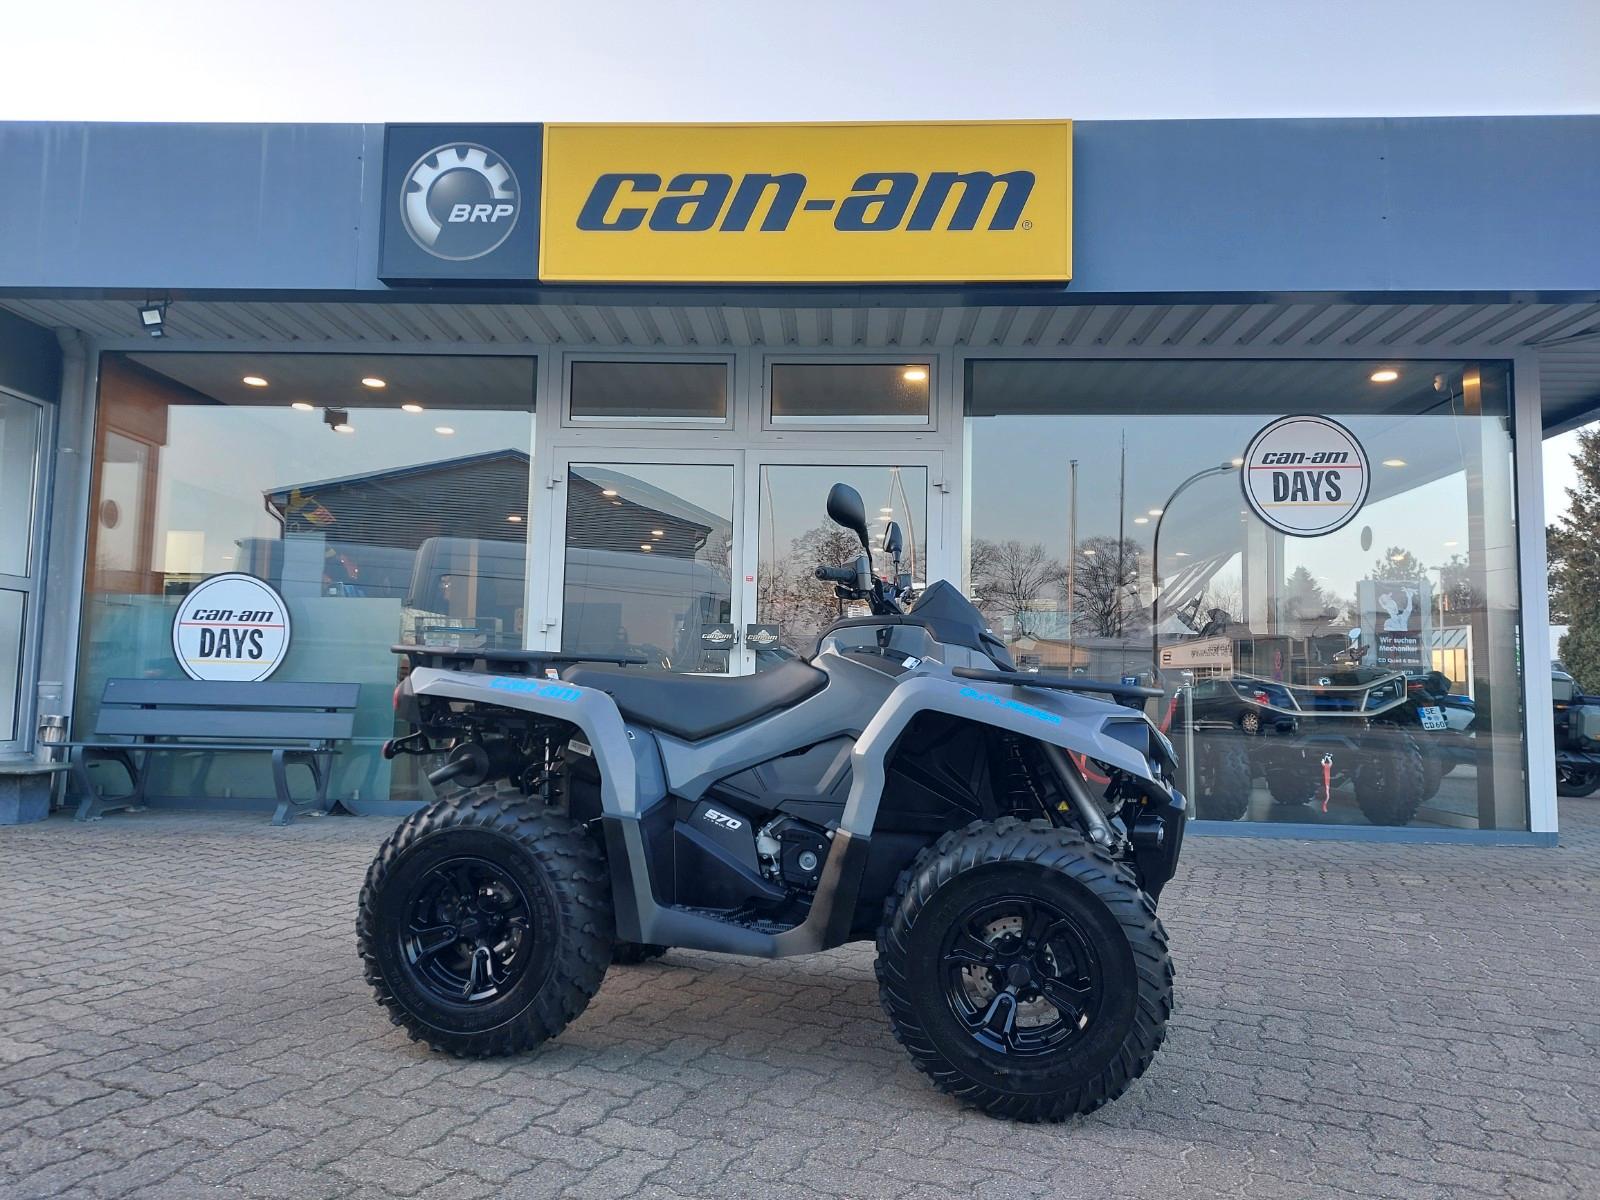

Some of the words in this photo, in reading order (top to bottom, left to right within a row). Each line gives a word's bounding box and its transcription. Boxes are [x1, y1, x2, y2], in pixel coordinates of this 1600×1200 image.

[576, 171, 1036, 231] can-am
[448, 203, 514, 223] BRP
[1262, 451, 1349, 465] can-am
[1272, 470, 1342, 502] DAYS
[192, 609, 274, 623] can-am
[199, 627, 264, 660] DAYS
[1379, 636, 1392, 644] Wir
[1393, 636, 1417, 645] suchen
[704, 808, 742, 830] 570
